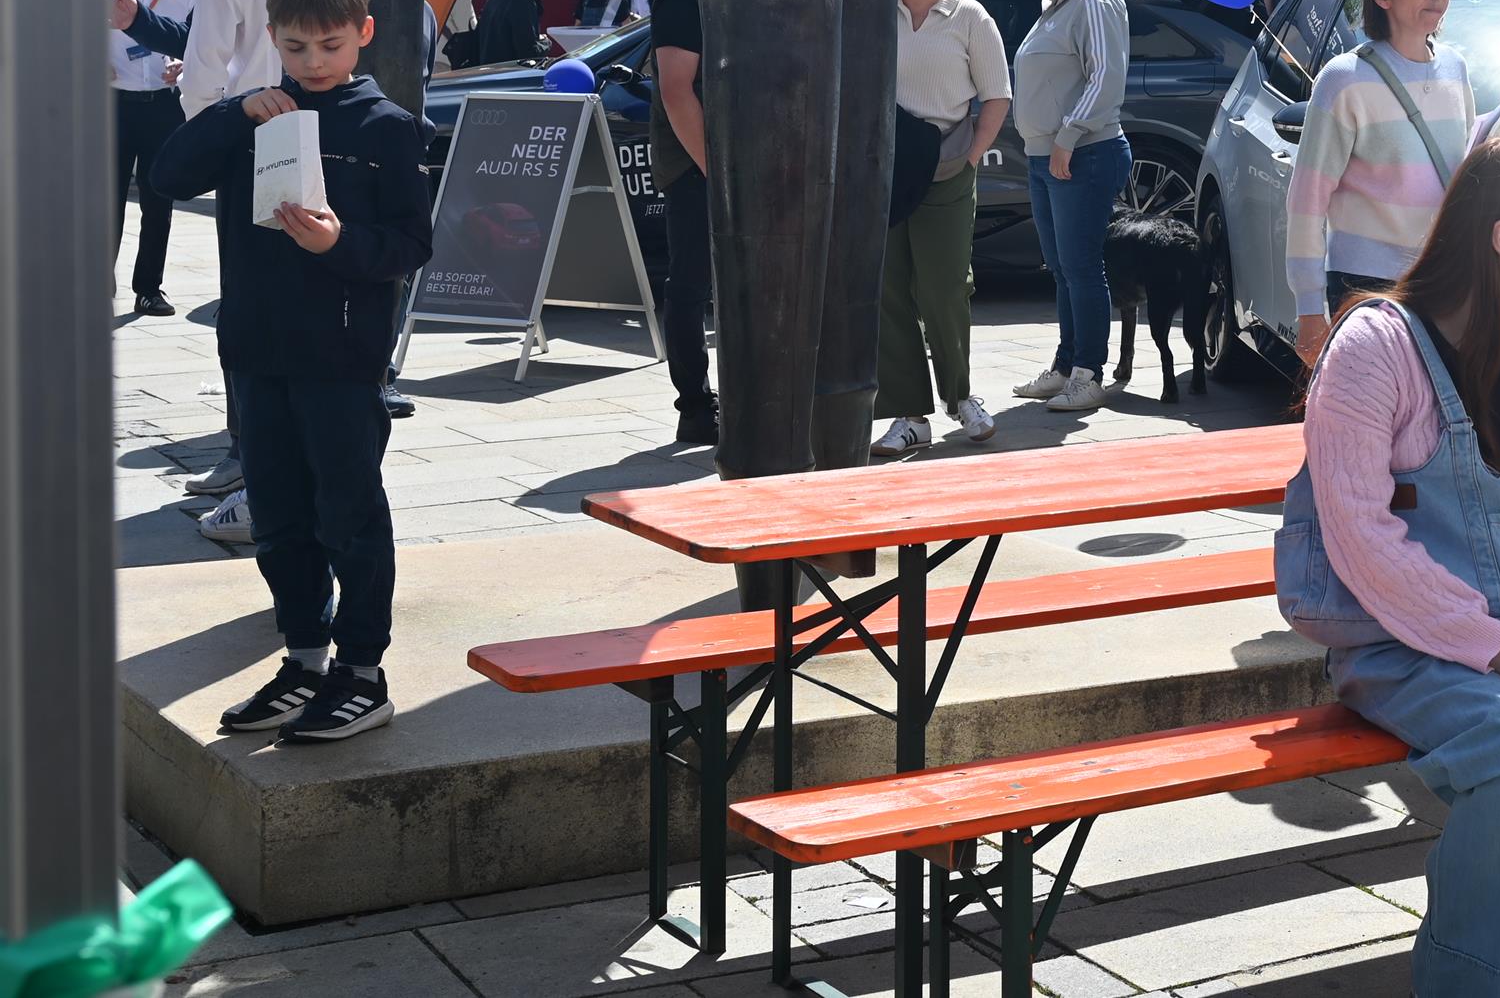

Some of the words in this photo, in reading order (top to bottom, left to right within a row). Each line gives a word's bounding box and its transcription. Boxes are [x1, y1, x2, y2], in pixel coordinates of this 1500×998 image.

[529, 126, 567, 141] DER
[511, 144, 563, 160] NEUE
[265, 157, 297, 171] HYUNDAI
[475, 160, 518, 175] AUDI
[522, 162, 544, 177] RS
[547, 163, 559, 177] 5
[645, 204, 665, 216] JETZT
[428, 271, 443, 282] AB
[444, 272, 487, 284] SOFORT
[426, 283, 494, 297] BESTELLBAR!
